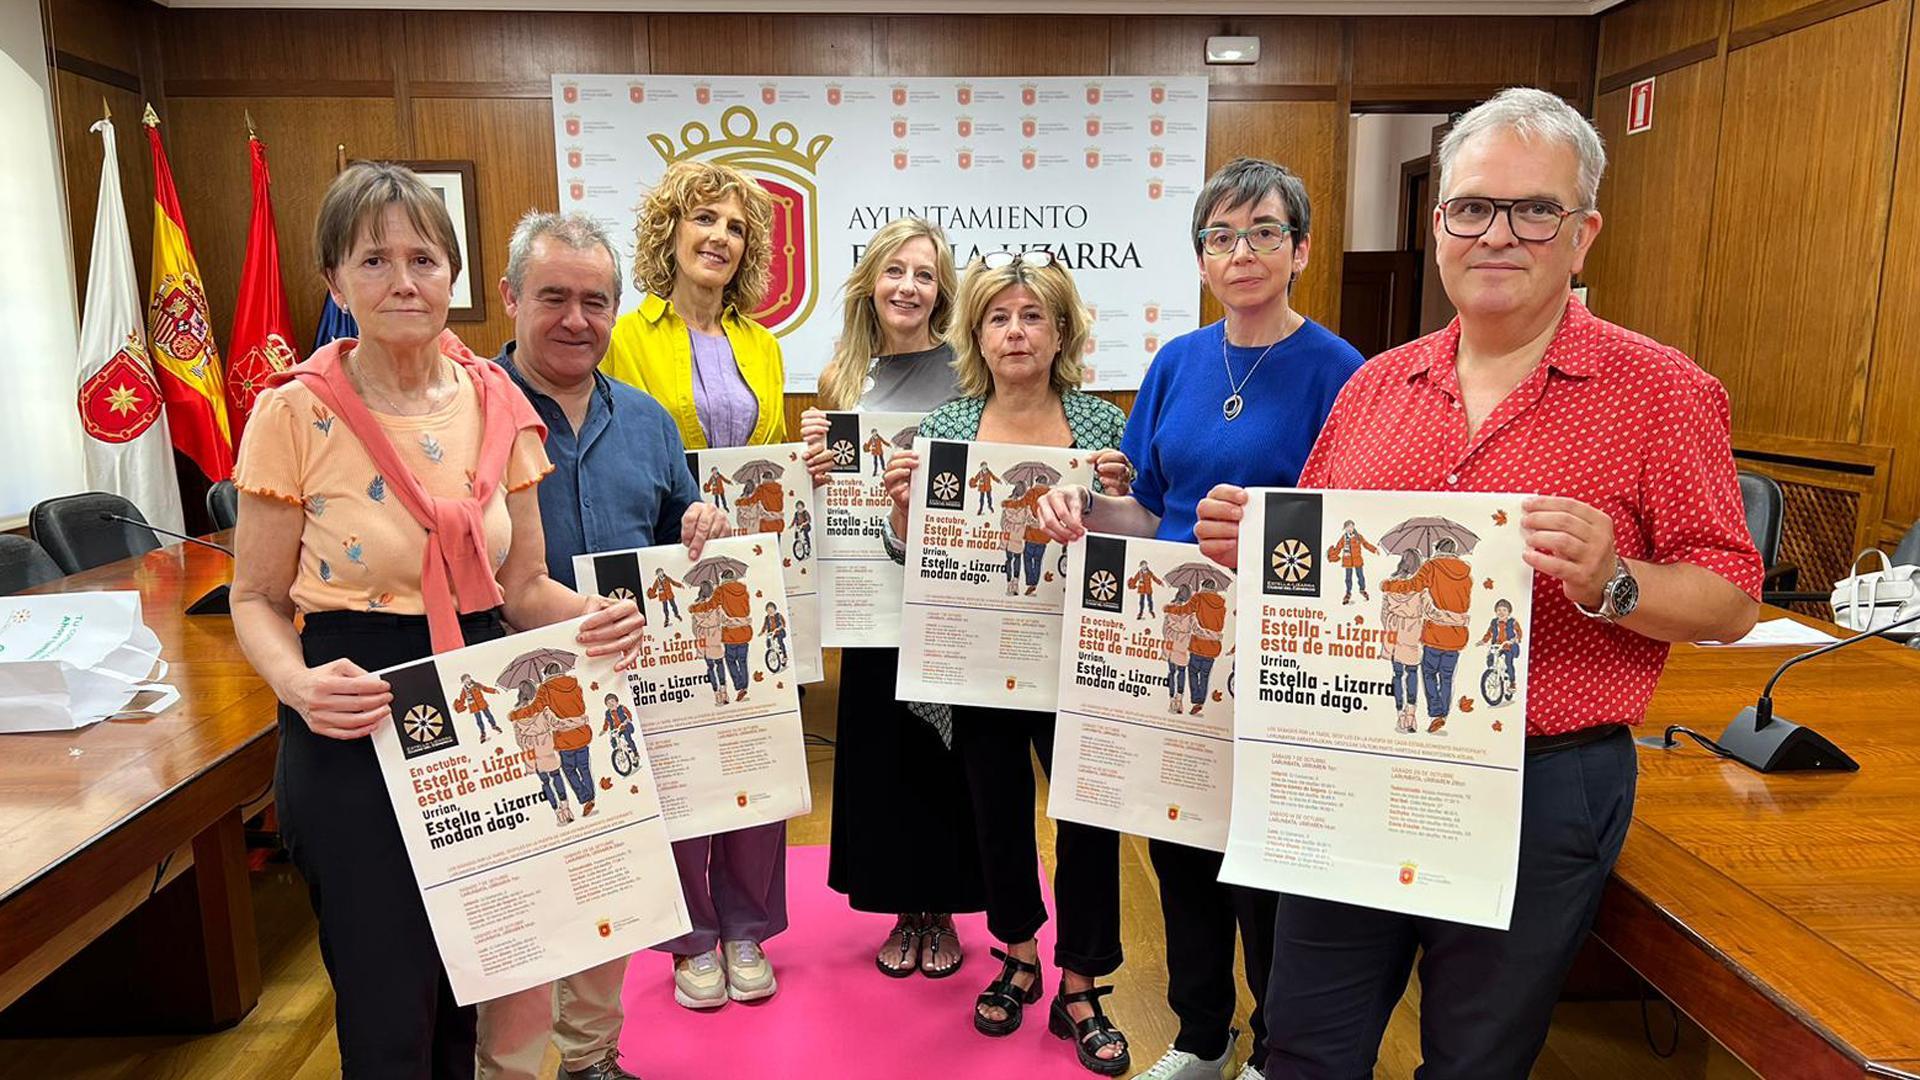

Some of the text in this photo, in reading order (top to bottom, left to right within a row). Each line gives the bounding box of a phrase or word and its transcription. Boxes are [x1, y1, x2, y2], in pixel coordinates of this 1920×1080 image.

[827, 486, 861, 497] Estella
[870, 486, 889, 497] Liza
[851, 497, 863, 506] de
[827, 516, 861, 527] Estella
[925, 514, 968, 526] En octubre,
[827, 526, 860, 536] modan
[924, 524, 962, 537] Estella
[972, 526, 1011, 541] Lizarra
[950, 536, 964, 548] de
[922, 547, 949, 557] Urrian,
[921, 557, 959, 570] Estella
[969, 559, 1008, 573] Lizarra
[920, 567, 990, 585] modan dago.
[1081, 615, 1091, 624] En
[1262, 605, 1327, 622] En octubre,
[1080, 625, 1120, 642] Estella
[1131, 632, 1174, 651] Lizarra
[1261, 618, 1320, 639] Estella
[1336, 622, 1398, 645] Lizarra
[663, 637, 707, 653] Lizarra
[1108, 641, 1122, 654] de
[1303, 638, 1323, 655] de
[1328, 641, 1381, 660] moda.
[641, 656, 656, 668] de
[1078, 651, 1106, 664] Urrian,
[1261, 655, 1300, 670] Urrian,
[1076, 661, 1117, 679] Estella
[1128, 668, 1170, 688] Lizarra
[1259, 669, 1318, 690] Estella
[1335, 673, 1395, 697] Lizarra
[631, 680, 656, 695] ella
[667, 675, 711, 689] Lizarra
[1075, 674, 1151, 698] modan dago.
[633, 688, 694, 706] dan dago.
[1259, 684, 1368, 714] modan dago.
[409, 755, 471, 779] En octubre,
[412, 768, 469, 794] Estella
[482, 748, 537, 774] Lizarra
[457, 781, 476, 796] de
[479, 764, 528, 790] moda.
[422, 803, 461, 820] Urrian,
[425, 809, 481, 837] Estella
[494, 791, 548, 816] Lizarra
[430, 812, 530, 850] modan dago.
